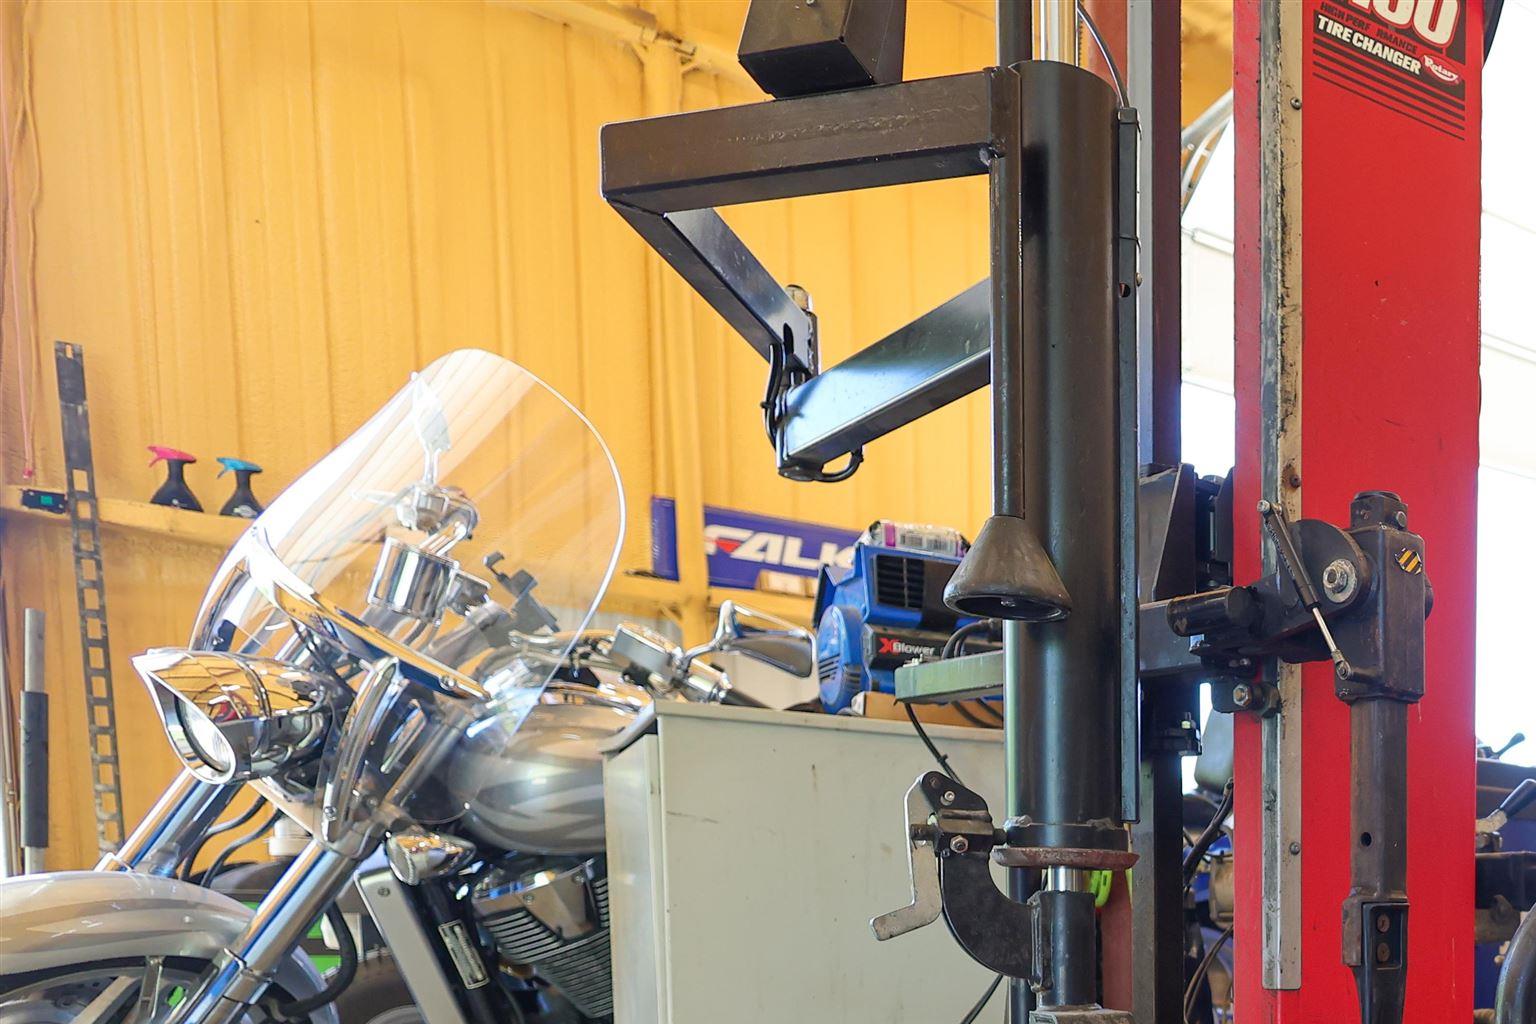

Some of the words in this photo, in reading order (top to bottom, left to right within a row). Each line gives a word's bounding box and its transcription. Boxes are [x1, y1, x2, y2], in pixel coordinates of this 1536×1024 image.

[1318, 15, 1352, 43] TIRE
[1352, 33, 1422, 75] CHANGER
[1345, 11, 1418, 55] PERFRMANCE
[1423, 54, 1459, 82] Rotary
